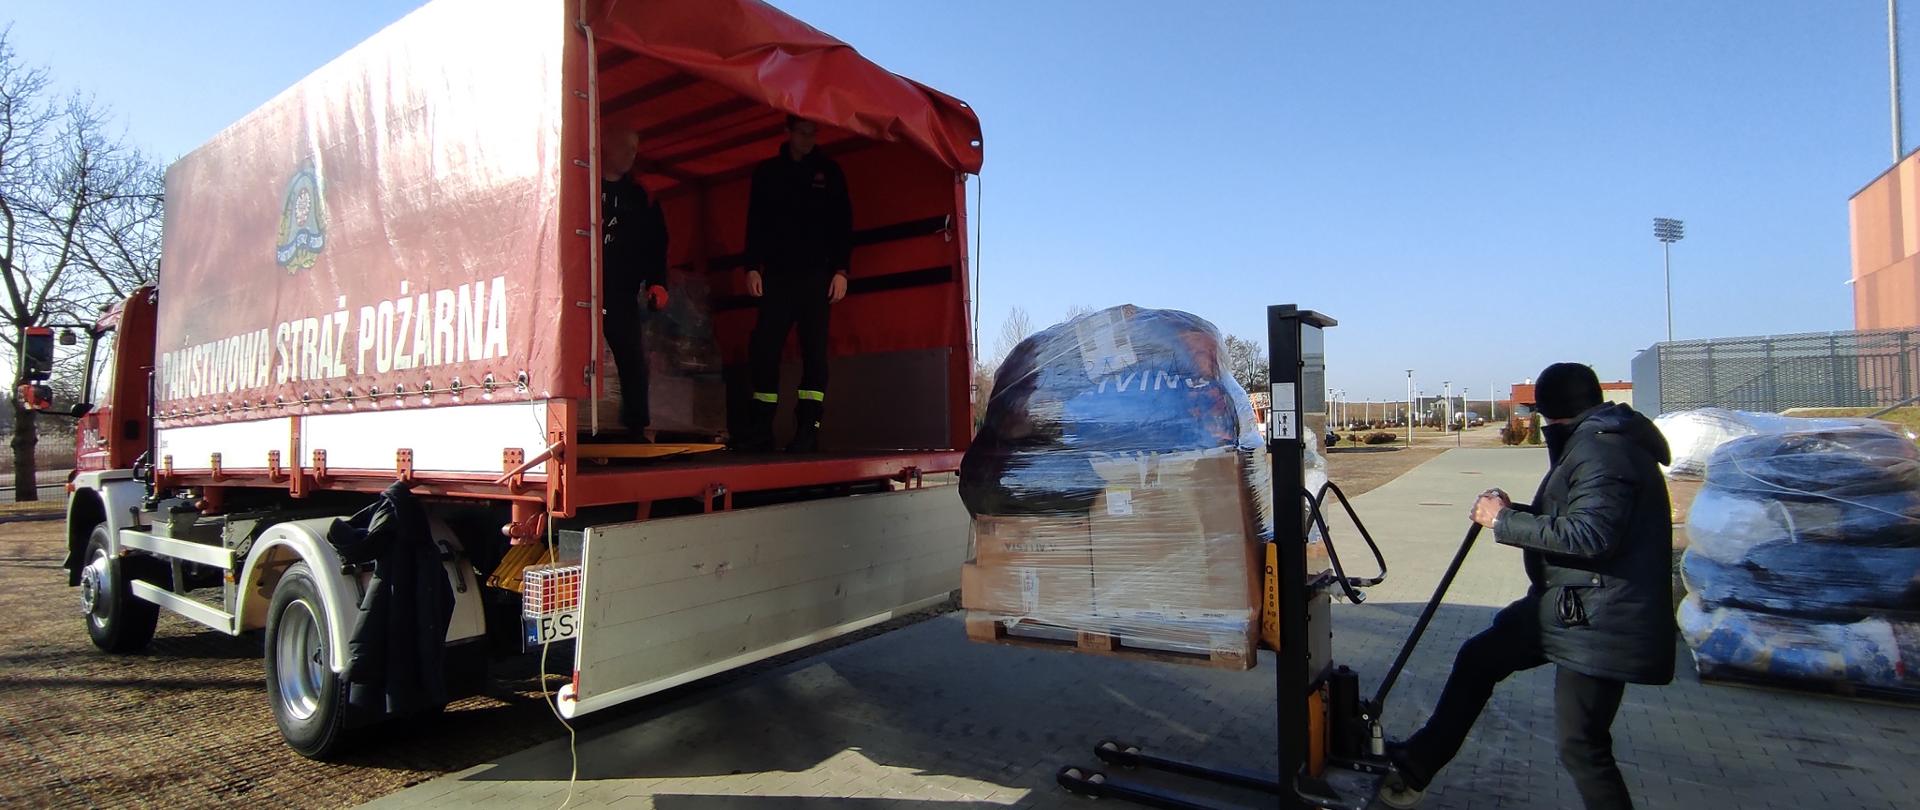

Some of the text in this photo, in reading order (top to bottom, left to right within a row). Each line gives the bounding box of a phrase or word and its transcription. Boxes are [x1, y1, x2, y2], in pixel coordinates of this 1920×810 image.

[161, 276, 508, 401] PAŃSTWOWA STRAŻ POŻARNA
[541, 614, 577, 641] BS
